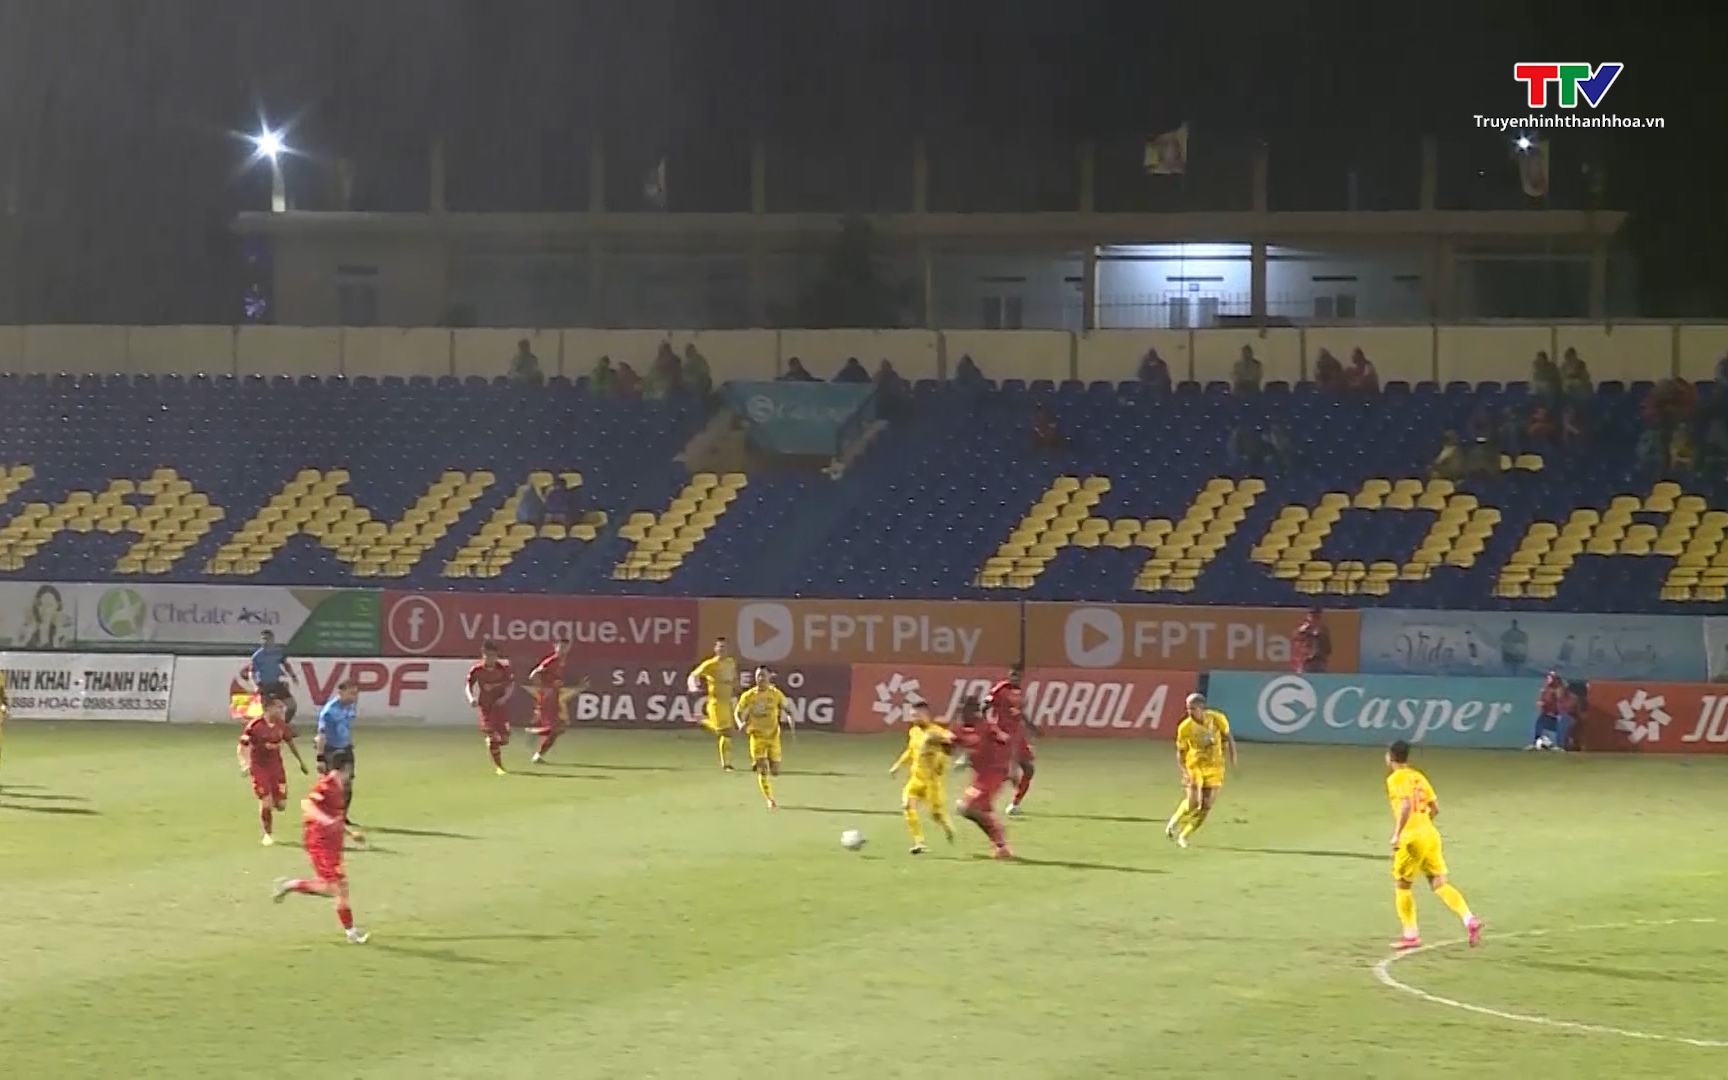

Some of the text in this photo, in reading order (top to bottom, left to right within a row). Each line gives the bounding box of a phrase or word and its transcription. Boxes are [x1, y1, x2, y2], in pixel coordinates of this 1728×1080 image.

[459, 613, 691, 644] V.League.VPF
[803, 614, 982, 663] FPT Play
[1133, 620, 1290, 662] FPT Pla
[0, 669, 31, 690] INH
[34, 670, 71, 690] KHAI
[84, 671, 134, 692] THANH
[301, 661, 429, 706] VPF
[576, 692, 637, 721] BIA
[1323, 685, 1513, 743] Casper
